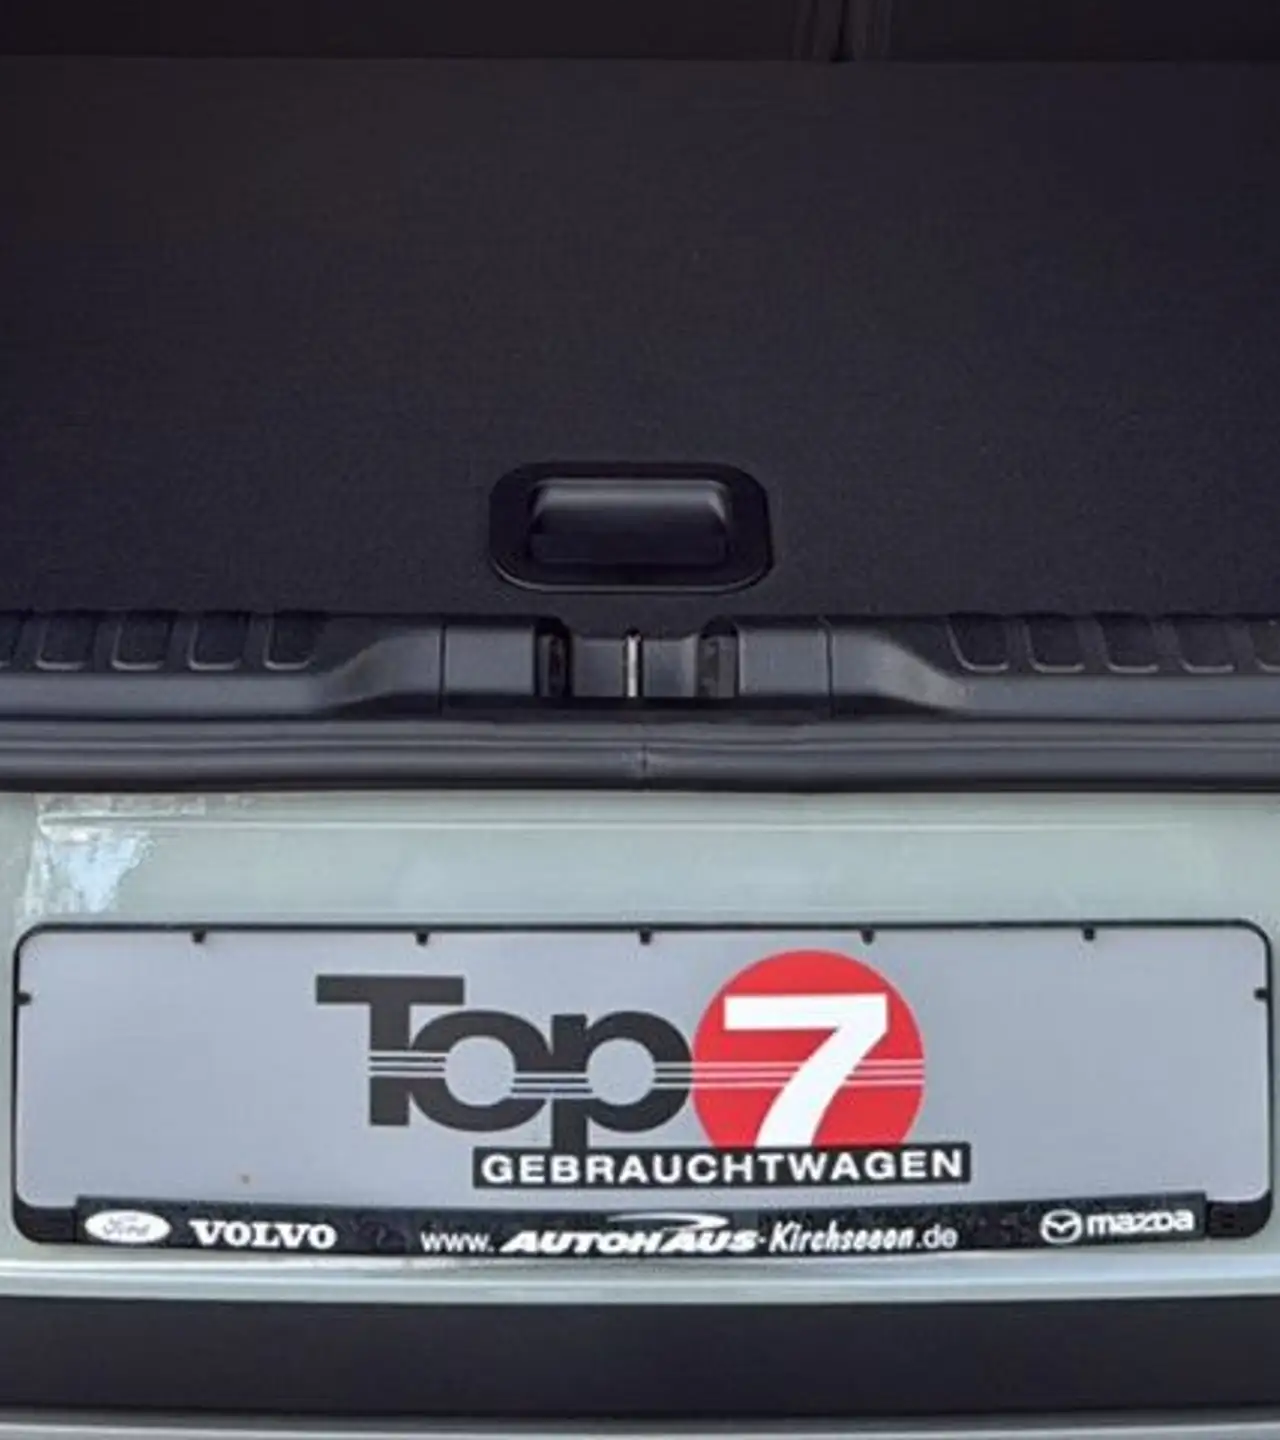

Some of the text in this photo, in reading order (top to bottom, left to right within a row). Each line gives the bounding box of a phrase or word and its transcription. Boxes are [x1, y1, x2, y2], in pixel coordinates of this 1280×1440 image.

[316, 976, 889, 1148] Top 7
[480, 1149, 964, 1185] GEBRAUCHTWAGEN
[188, 1218, 338, 1250] VOLVO
[1086, 1209, 1195, 1237] mazda
